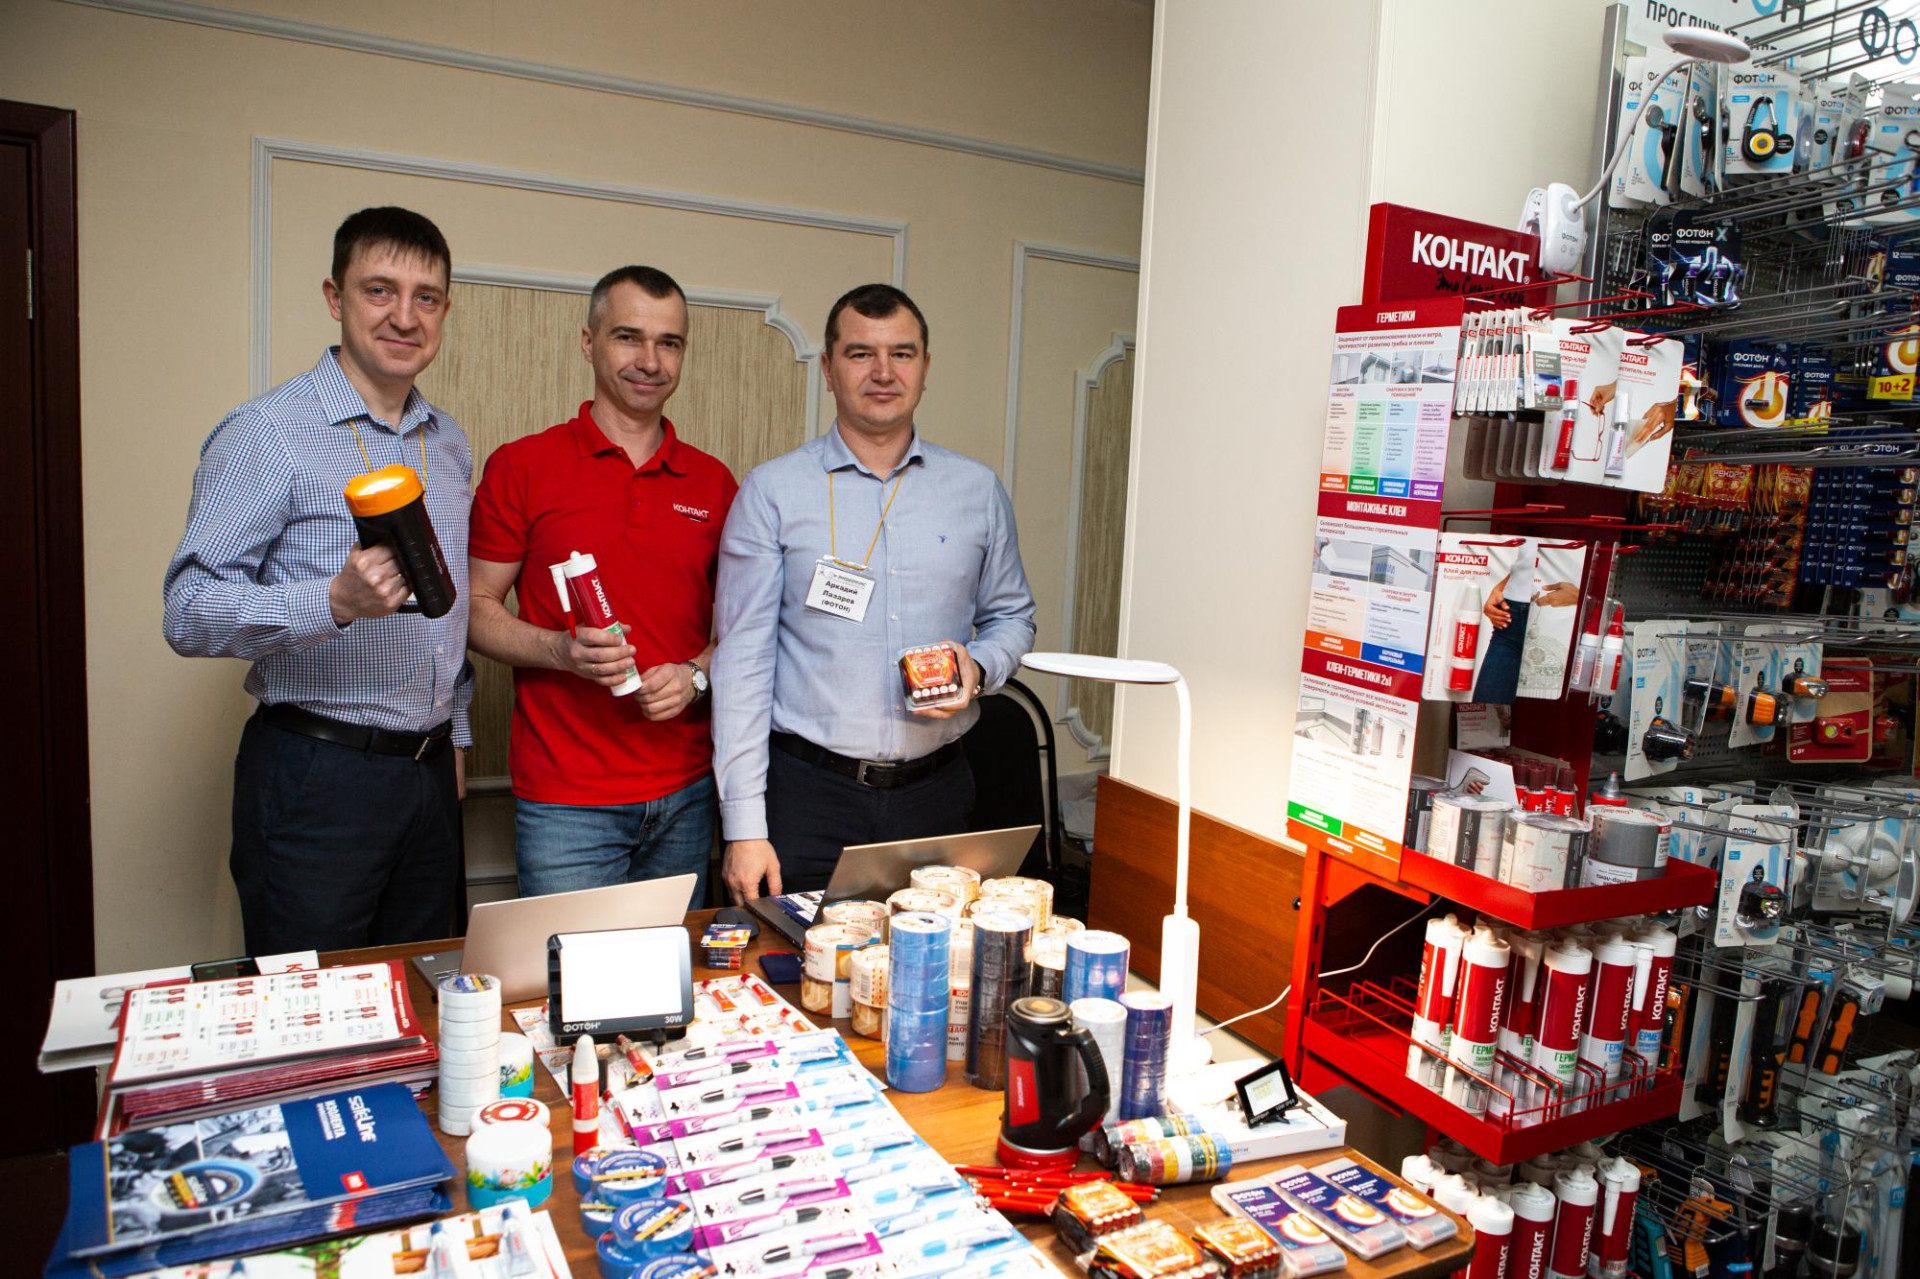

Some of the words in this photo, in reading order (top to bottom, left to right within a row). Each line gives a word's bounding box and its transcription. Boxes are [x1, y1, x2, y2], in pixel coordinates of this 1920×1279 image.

[1648, 72, 1678, 87] ФОН
[1733, 73, 1775, 85] ФОТОН
[1676, 228, 1713, 238] ФОТОН
[1412, 231, 1529, 283] КОНТАКТ
[1376, 310, 1416, 324] ГЕРМЕТИКИ
[1620, 353, 1647, 365] ОНТАКТ
[1733, 352, 1769, 363] ФОТОН
[1873, 444, 1899, 453] ОТОН
[1713, 469, 1746, 479] РЕКОРД
[673, 503, 710, 518] КОНТАКТ
[1346, 500, 1387, 516] МОНТАЖНЫЕ
[1388, 505, 1407, 517] КЛЕИ
[1444, 554, 1486, 565] КОНТАКТ
[1460, 569, 1472, 577] для
[825, 580, 858, 595] Аркадий
[591, 578, 613, 619] КОНТАКТ
[822, 589, 855, 605] Лазарев
[821, 598, 851, 613] (ФОТОН)
[1457, 624, 1466, 654] КОНТАКТ
[1637, 649, 1657, 659] ФОТОН
[1652, 967, 1669, 1020] КОНТАКТ
[1489, 978, 1505, 1033] КОНТАКТ
[1620, 976, 1635, 1031] КОНТАКТ
[664, 1015, 683, 1024] 30W
[1571, 984, 1585, 1041] КОНТАКТ
[563, 1022, 598, 1033] ФОТОН
[324, 1099, 347, 1139] ИЗОЛЕНТА
[1280, 1175, 1310, 1189] ФОТОН
[1331, 1168, 1360, 1182] ФОТОН
[1232, 1189, 1265, 1201] ФОТОН
[1579, 1216, 1594, 1267] КОНТАКТ
